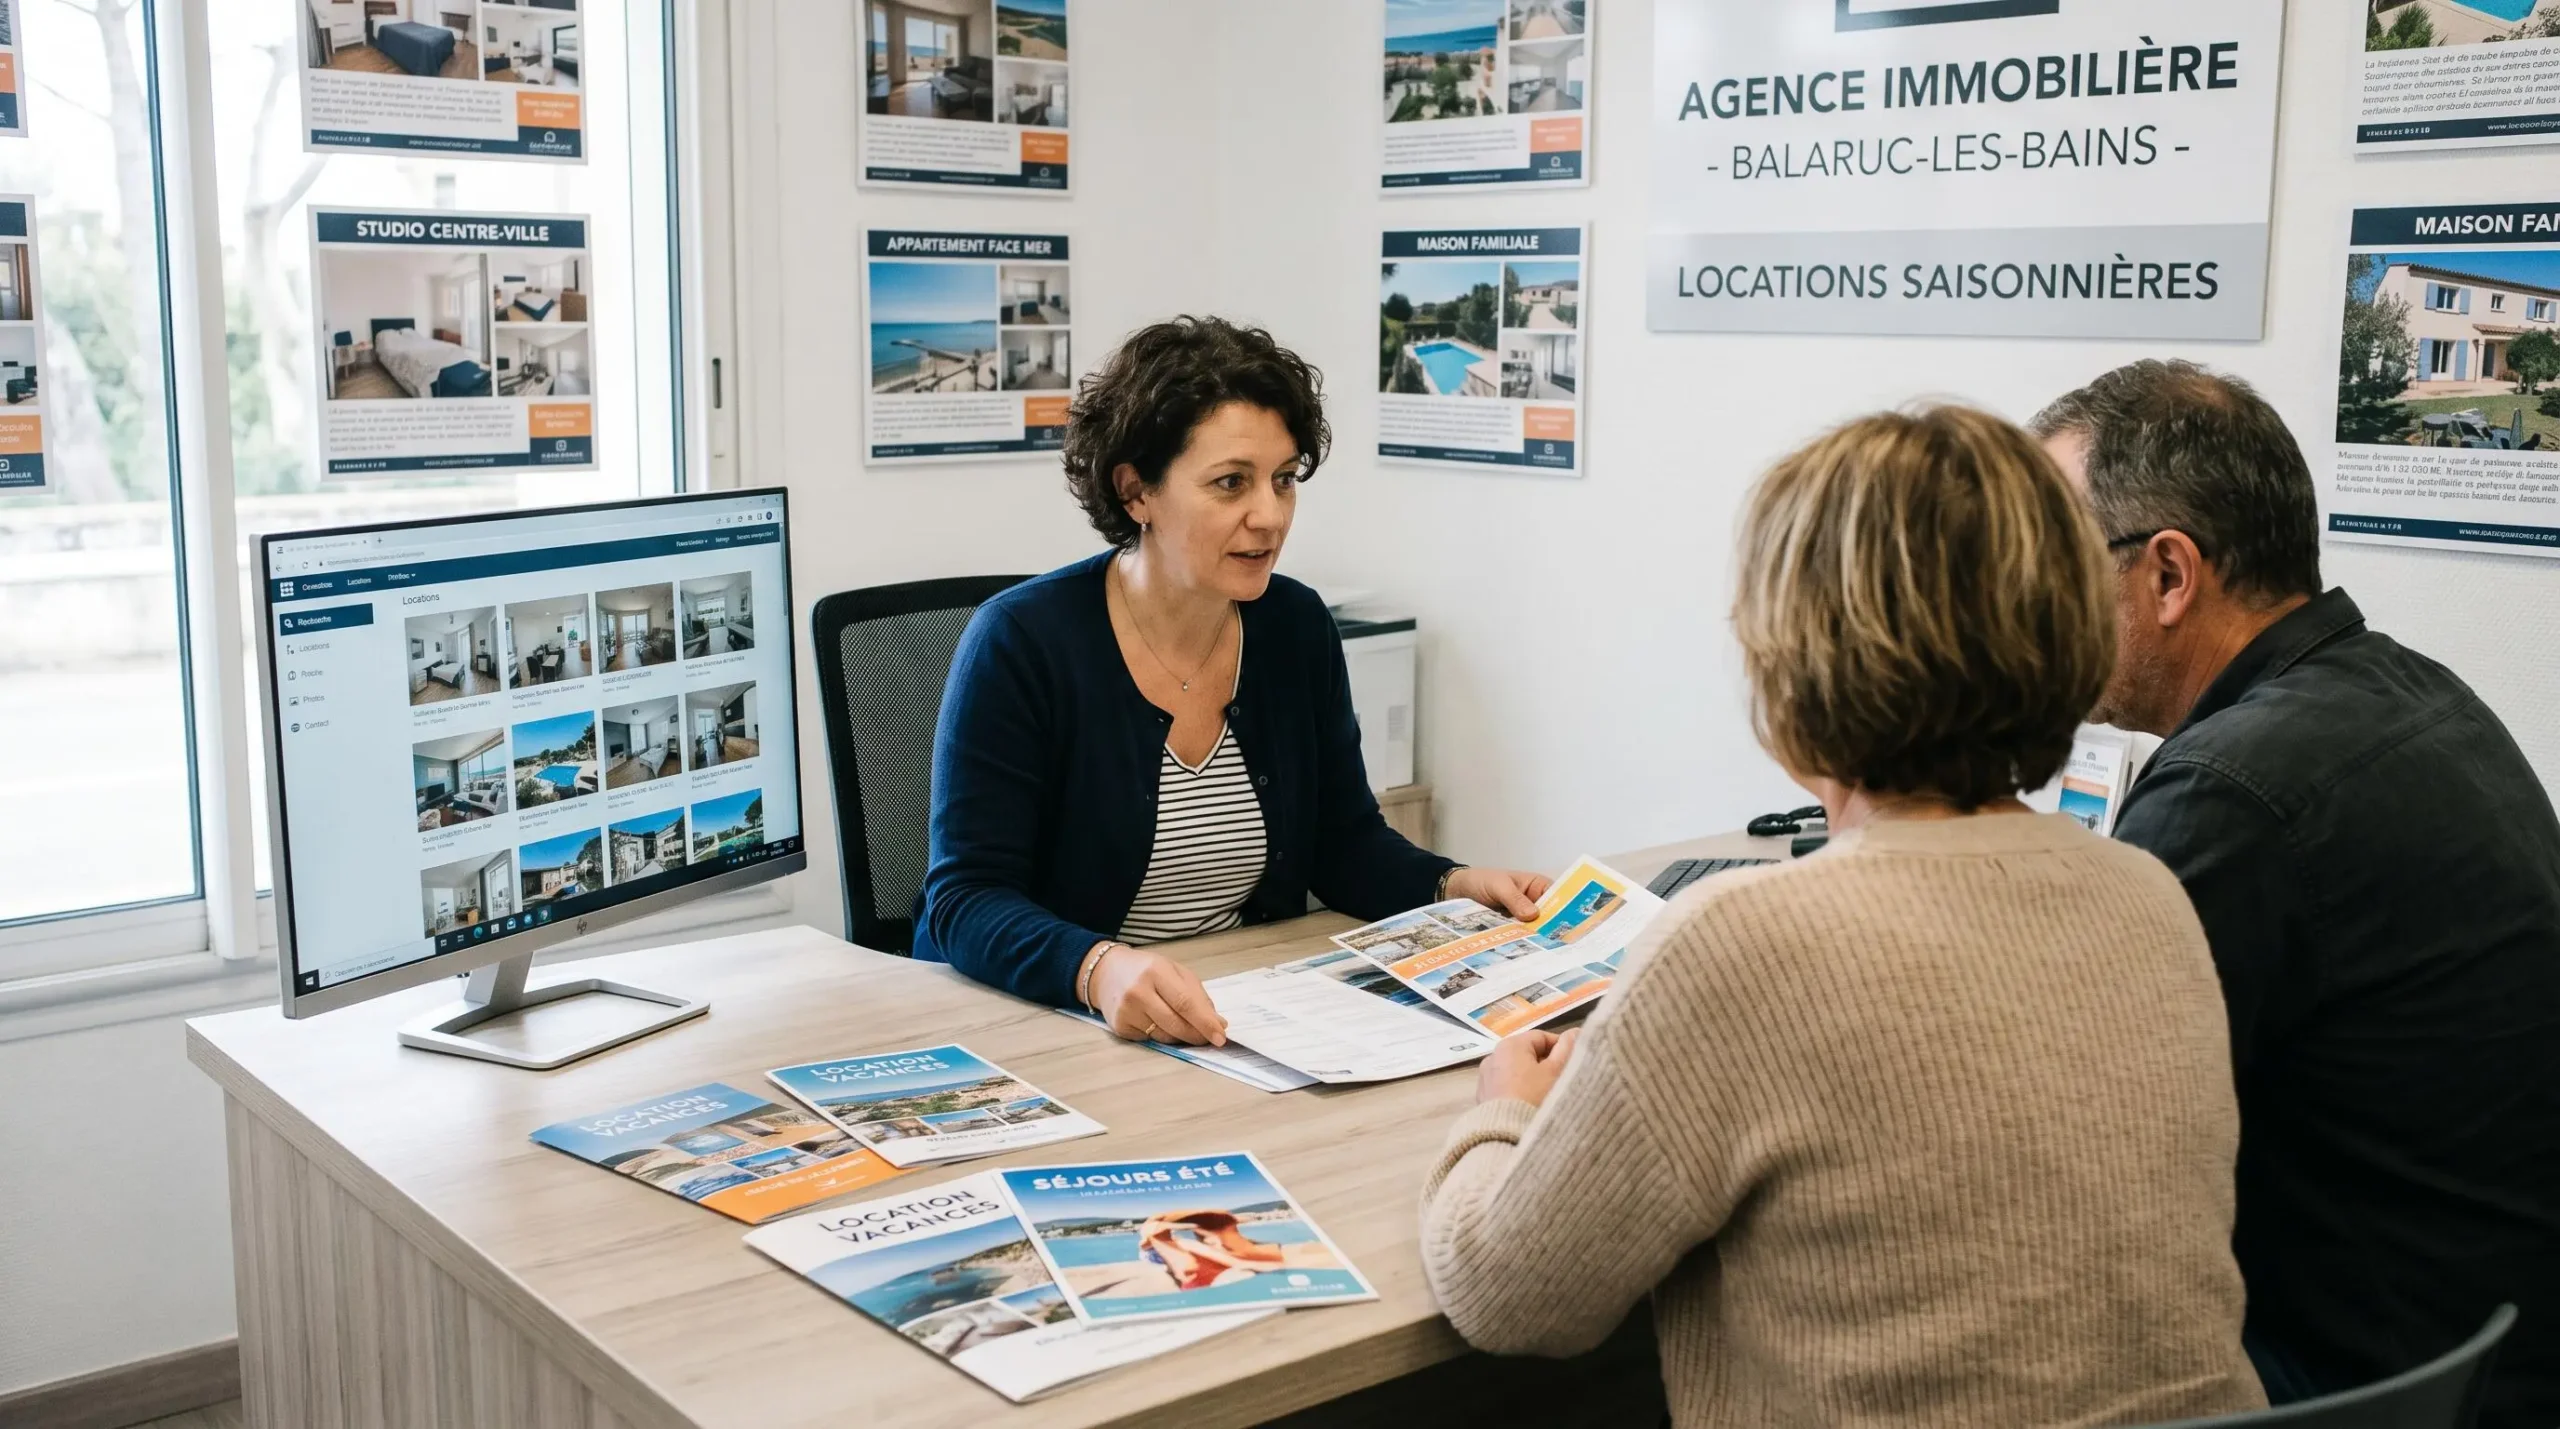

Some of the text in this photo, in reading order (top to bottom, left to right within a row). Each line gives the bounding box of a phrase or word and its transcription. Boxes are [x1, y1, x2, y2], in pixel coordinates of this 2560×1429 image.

[1678, 35, 2239, 121] AGENCE IMMOBILIÈRE
[1732, 124, 2158, 179] BALARUC-LES-BAINS
[357, 220, 549, 242] STUDIO CENTRE-VILLE
[2415, 214, 2513, 236] MAISON
[886, 236, 1052, 254] APPARTEMENT FACE MER
[1417, 235, 1539, 251] MAISON FAMILIALE
[1678, 253, 2219, 300] LOCATIONS SAISONNIÈRES
[402, 593, 440, 605] Locations
[810, 1054, 938, 1078] LOCATION
[819, 1061, 950, 1084] VACANCES
[579, 1095, 710, 1133] LOCATION
[591, 1101, 729, 1138] VACANCES
[1032, 1161, 1236, 1191] SÉJOURS ÉTÉ
[817, 1190, 977, 1233] LOCATION
[836, 1200, 1000, 1244] VACANCES
